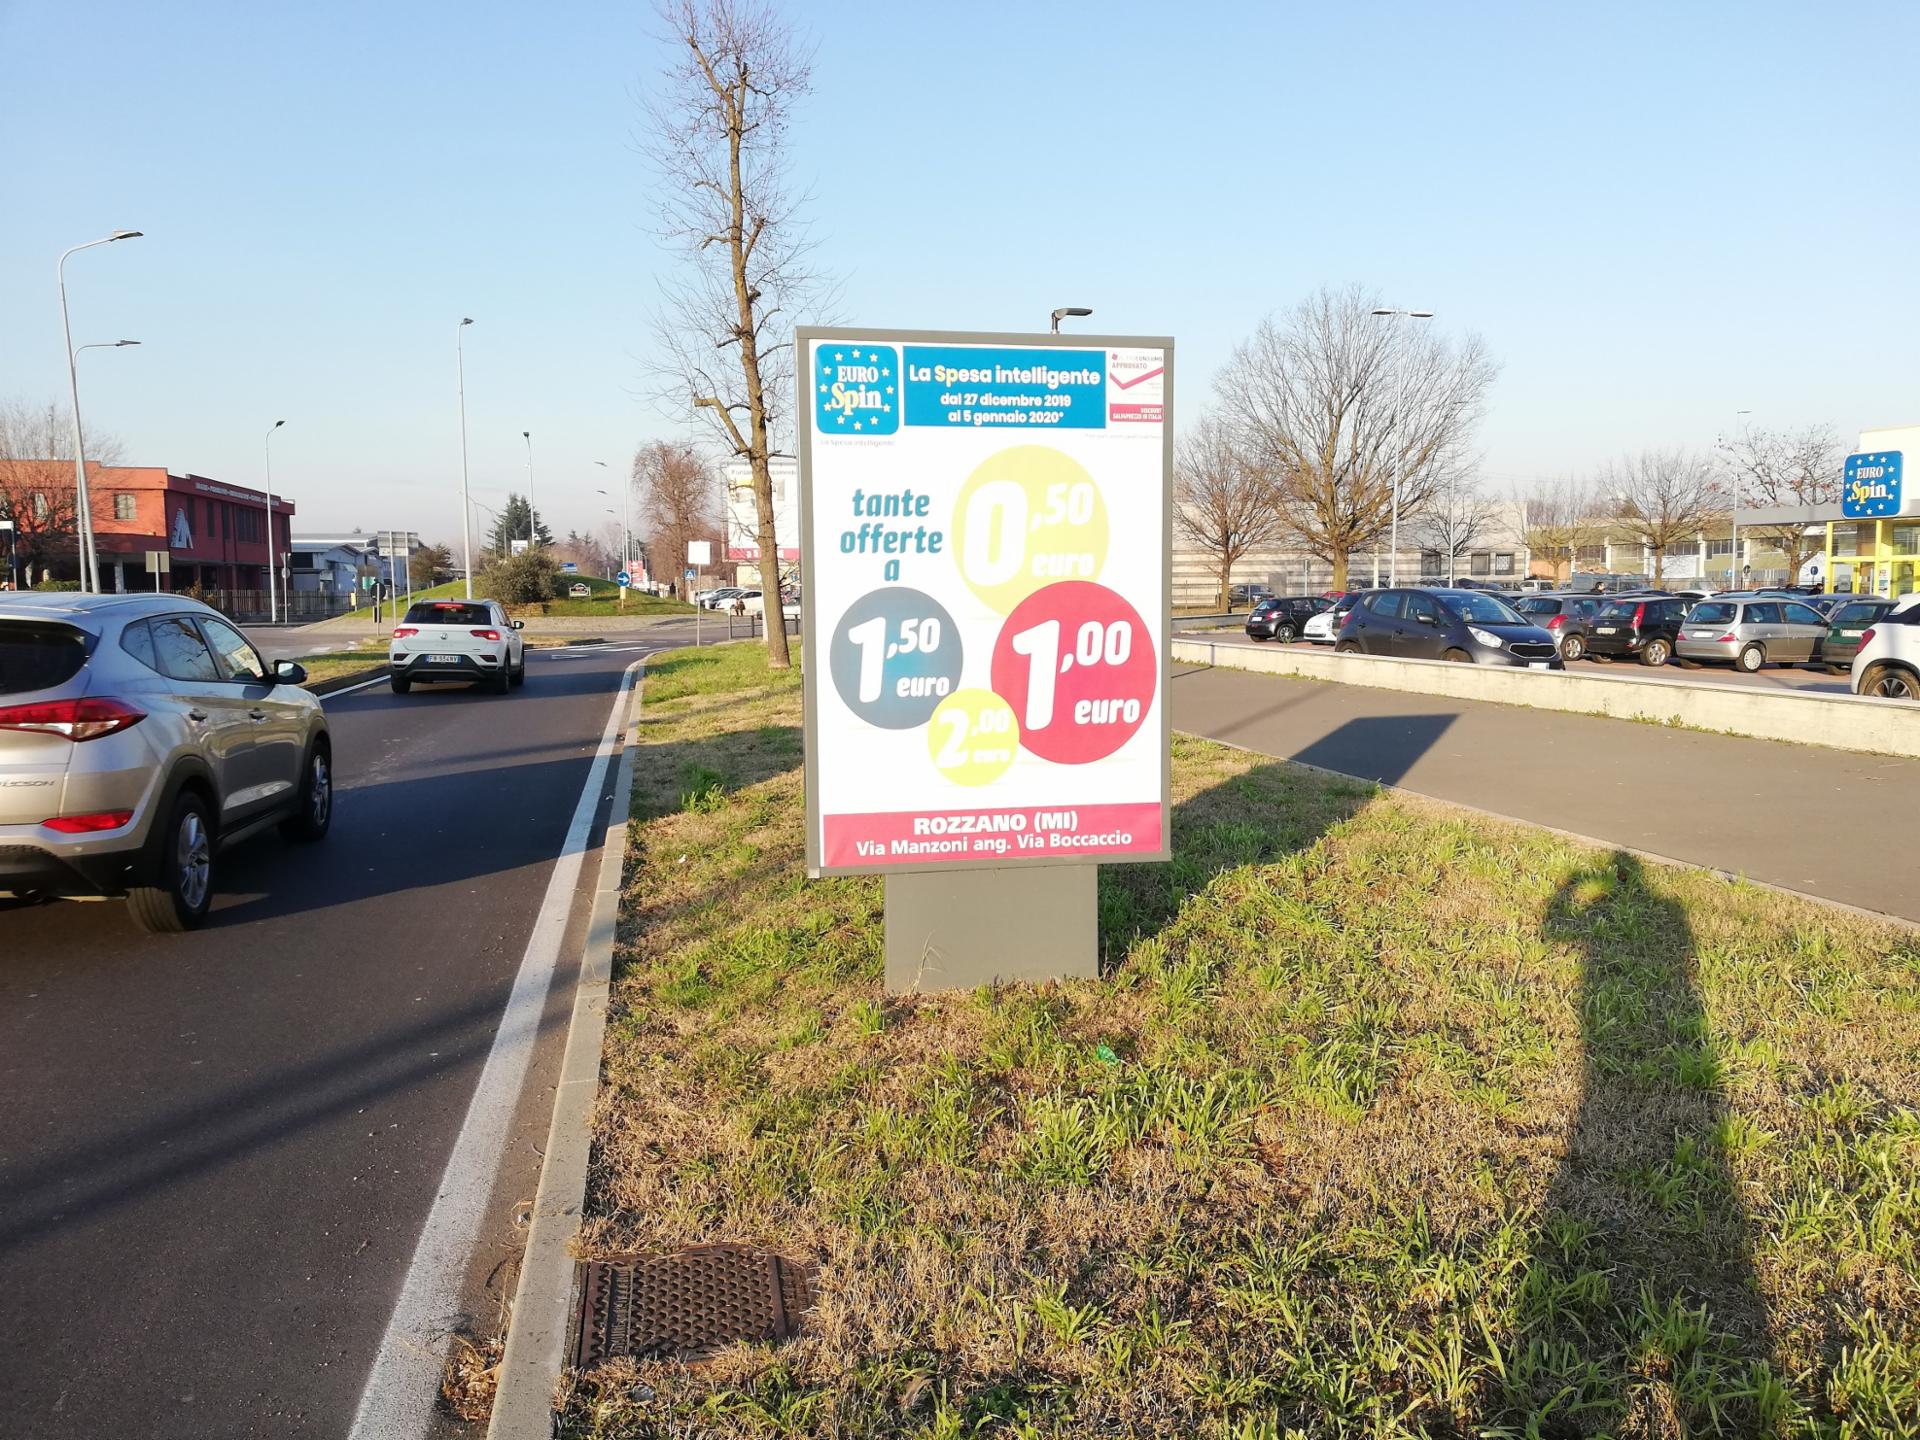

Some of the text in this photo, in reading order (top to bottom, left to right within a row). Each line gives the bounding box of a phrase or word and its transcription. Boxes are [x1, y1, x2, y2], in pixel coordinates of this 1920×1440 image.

[837, 366, 879, 383] EURO
[909, 364, 1101, 389] La Spesa intelligente
[831, 382, 883, 415] Spin
[940, 393, 1072, 407] dal 27 dicembre 2019
[948, 409, 961, 422] al
[963, 410, 971, 422] 5
[973, 410, 1027, 426] gennaio
[1856, 466, 1884, 479] EURO
[852, 488, 931, 517] tante
[1850, 480, 1888, 504] Spin
[840, 523, 943, 554] offerte
[884, 559, 900, 582] a
[1031, 552, 1094, 577] euro
[896, 675, 950, 698] euro
[1074, 698, 1140, 725] euro
[913, 811, 1078, 836] ROZZANO (MI)
[856, 829, 1132, 856] Via Manzoni ang. Via Boccaccio
